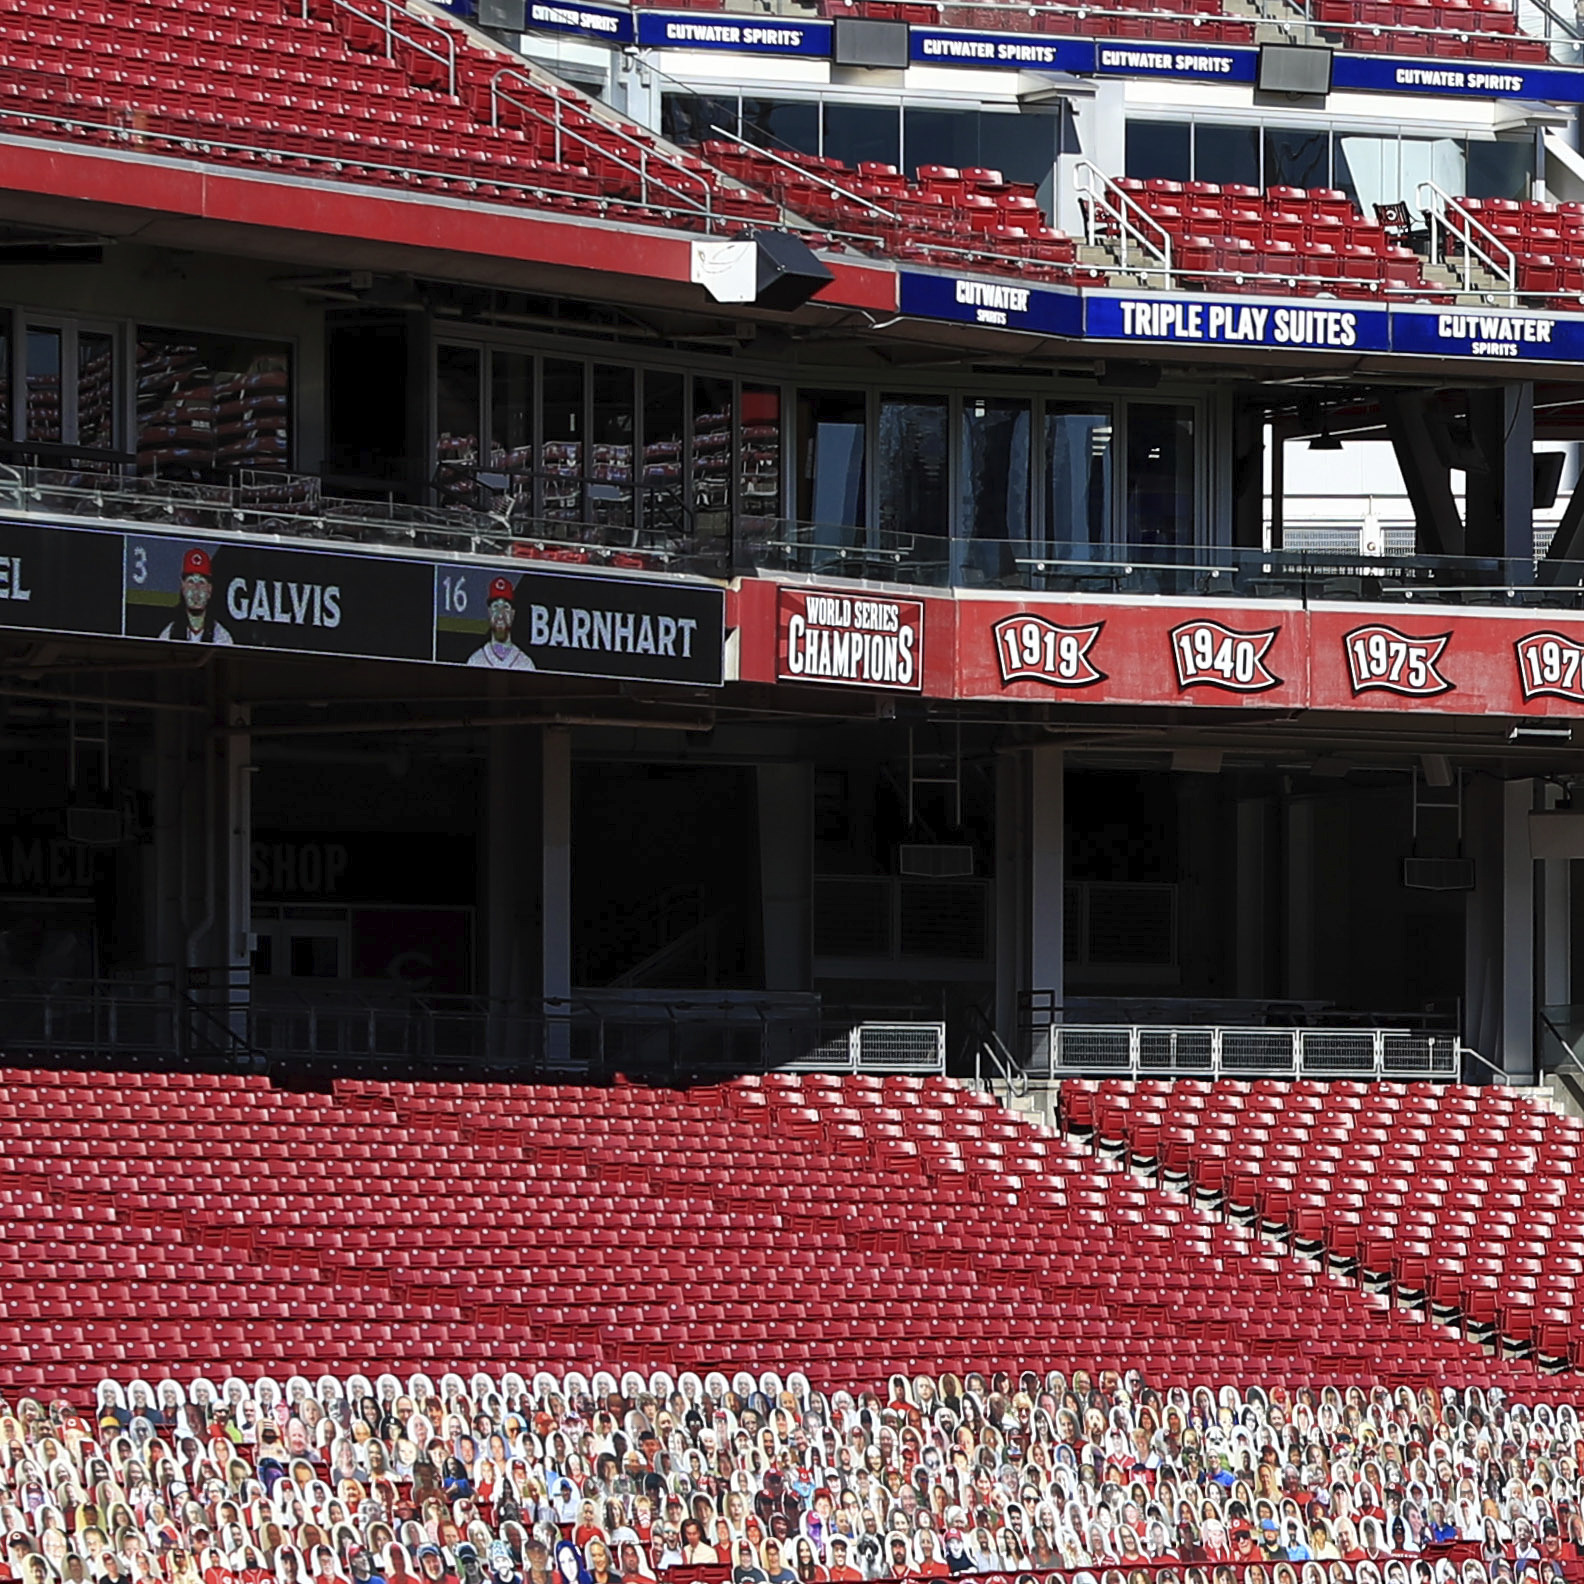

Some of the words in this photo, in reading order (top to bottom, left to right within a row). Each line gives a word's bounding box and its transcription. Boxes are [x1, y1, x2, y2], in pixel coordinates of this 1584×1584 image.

[532, 4, 579, 26] CUTWATER
[580, 13, 620, 33] SPIRITS
[666, 23, 740, 44] CUTWATER
[743, 29, 800, 47] SPIRITS
[923, 38, 996, 59] CUTWATER
[998, 43, 1054, 62] SPIRITS
[1101, 50, 1173, 71] CUTWATER
[1176, 55, 1231, 74] SPIRITS
[1396, 69, 1465, 89] CUTWATER
[1467, 73, 1522, 92] SPIRITS
[955, 280, 1028, 313] CUTWATER
[976, 309, 1007, 326] SPIRITS
[1121, 300, 1204, 340] TRIPLE
[1208, 304, 1265, 343] PLAY
[1274, 308, 1357, 347] SUITES
[1438, 314, 1554, 344] CUTWATER
[1471, 342, 1518, 358] SPIRITS
[133, 547, 148, 585] 3
[227, 576, 341, 629] GALVIS
[442, 576, 468, 613] 16
[529, 603, 698, 660] BARNHART
[805, 596, 852, 627] WORLD
[854, 600, 898, 633] SERIES
[788, 613, 914, 685] CHAMPIONS
[1003, 622, 1080, 679] 1919
[1178, 628, 1254, 683] 1940
[1352, 635, 1427, 689] 1975
[250, 842, 348, 893] SHOP
